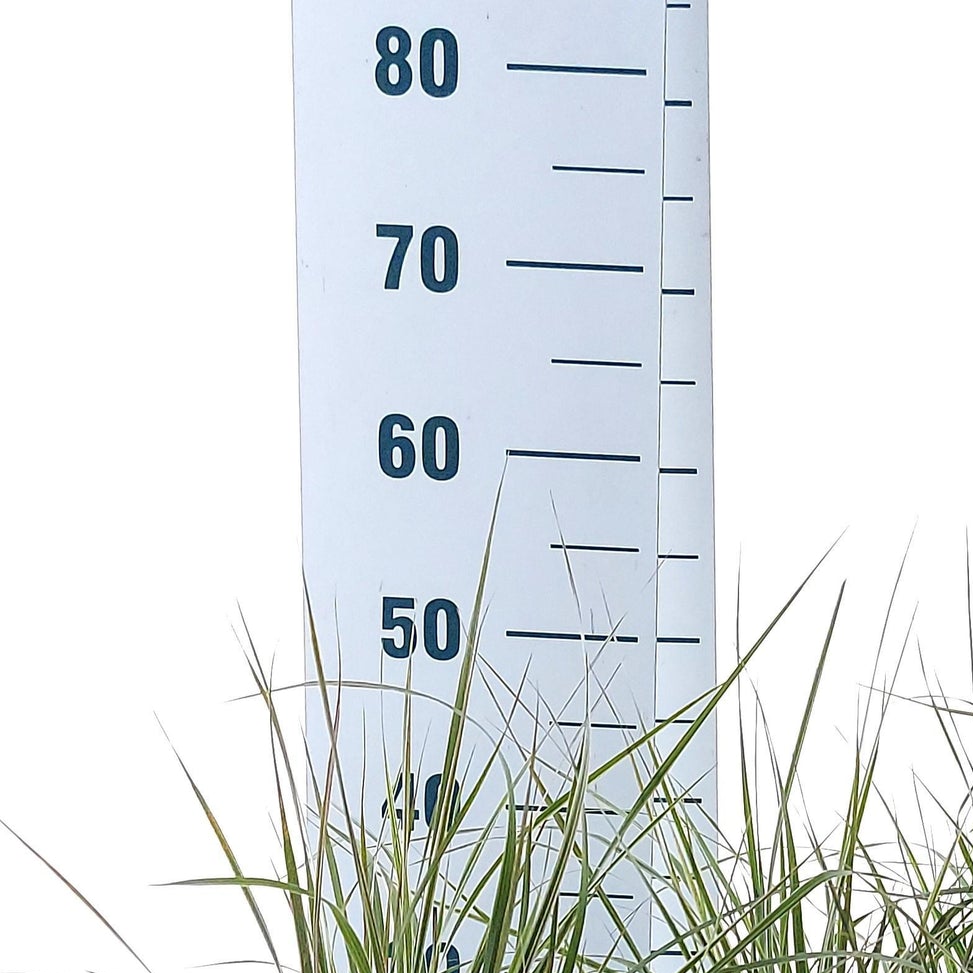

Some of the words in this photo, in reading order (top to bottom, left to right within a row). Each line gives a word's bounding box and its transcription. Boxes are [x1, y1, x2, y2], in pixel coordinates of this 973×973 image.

[374, 25, 459, 98] 80
[375, 223, 459, 294] 70
[378, 413, 460, 482] 60
[380, 596, 461, 661] 50
